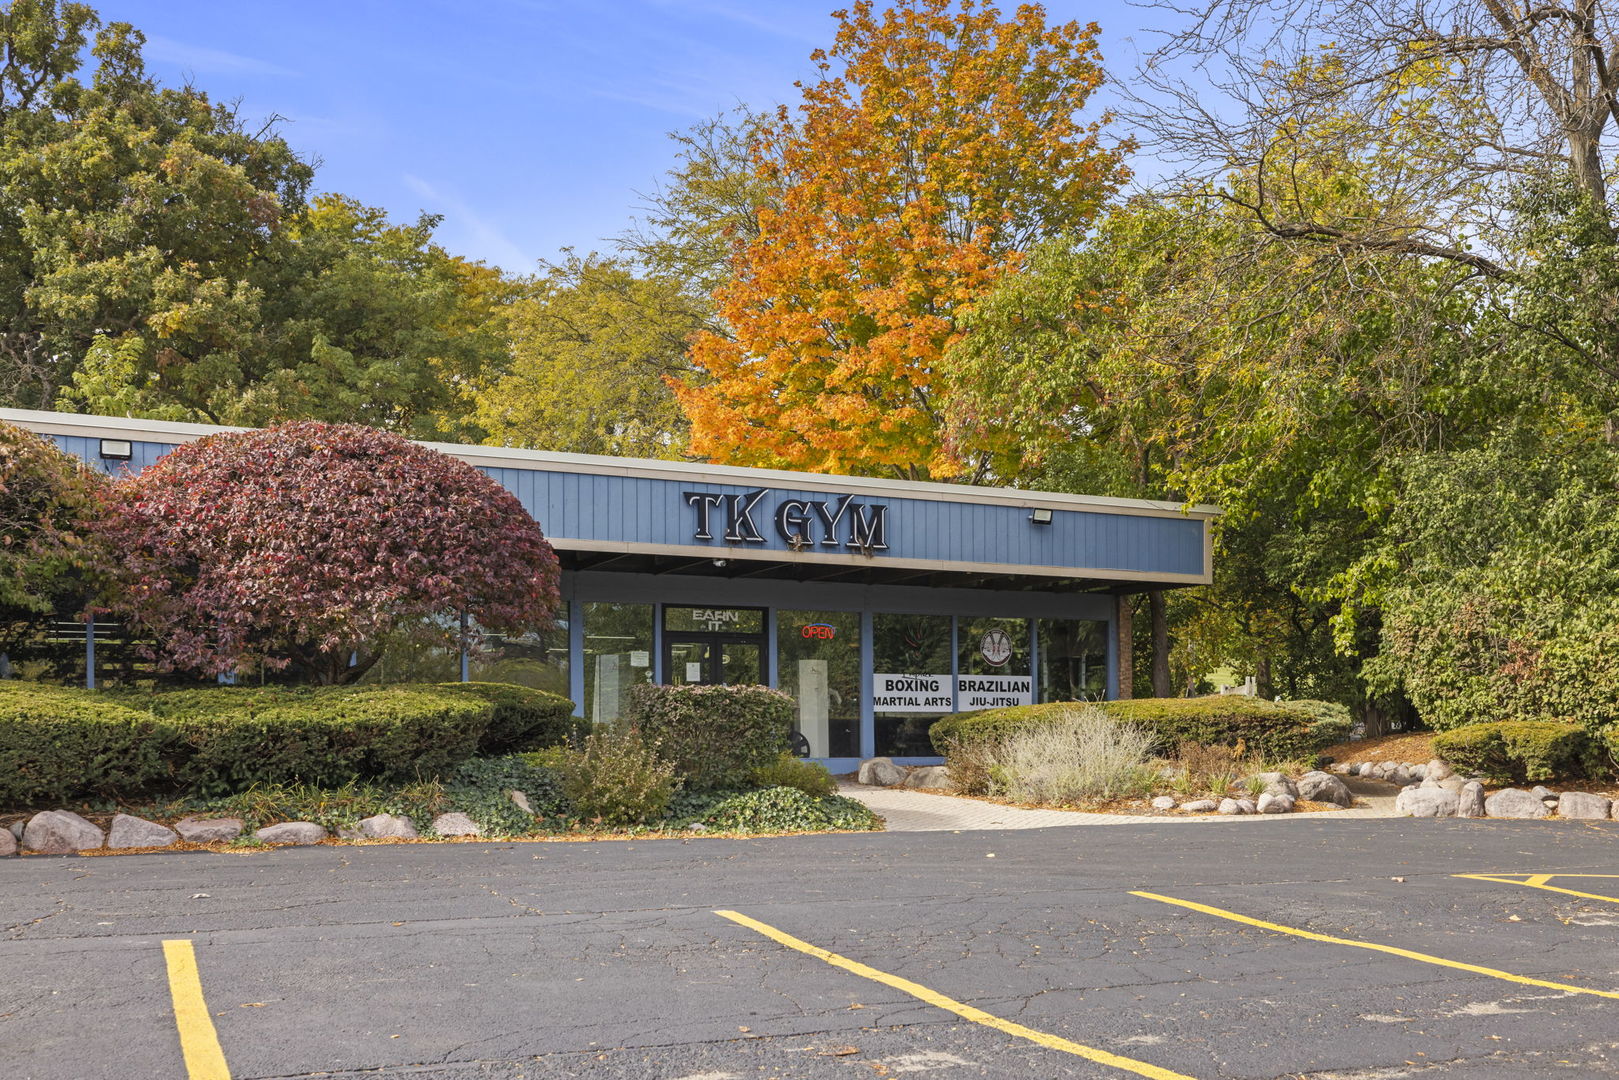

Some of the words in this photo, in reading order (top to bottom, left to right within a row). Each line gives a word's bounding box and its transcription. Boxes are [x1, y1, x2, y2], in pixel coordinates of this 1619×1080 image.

[683, 487, 768, 542] TK
[775, 495, 888, 548] GYM
[692, 610, 739, 621] EARN
[707, 620, 723, 631] IT
[802, 626, 835, 639] OPEN
[885, 679, 940, 692] BOXING
[958, 680, 1030, 693] BRAZILIAN
[873, 696, 921, 707] MARTIAL
[923, 696, 952, 707] ARTS
[969, 697, 1020, 707] JIU-JITSU
